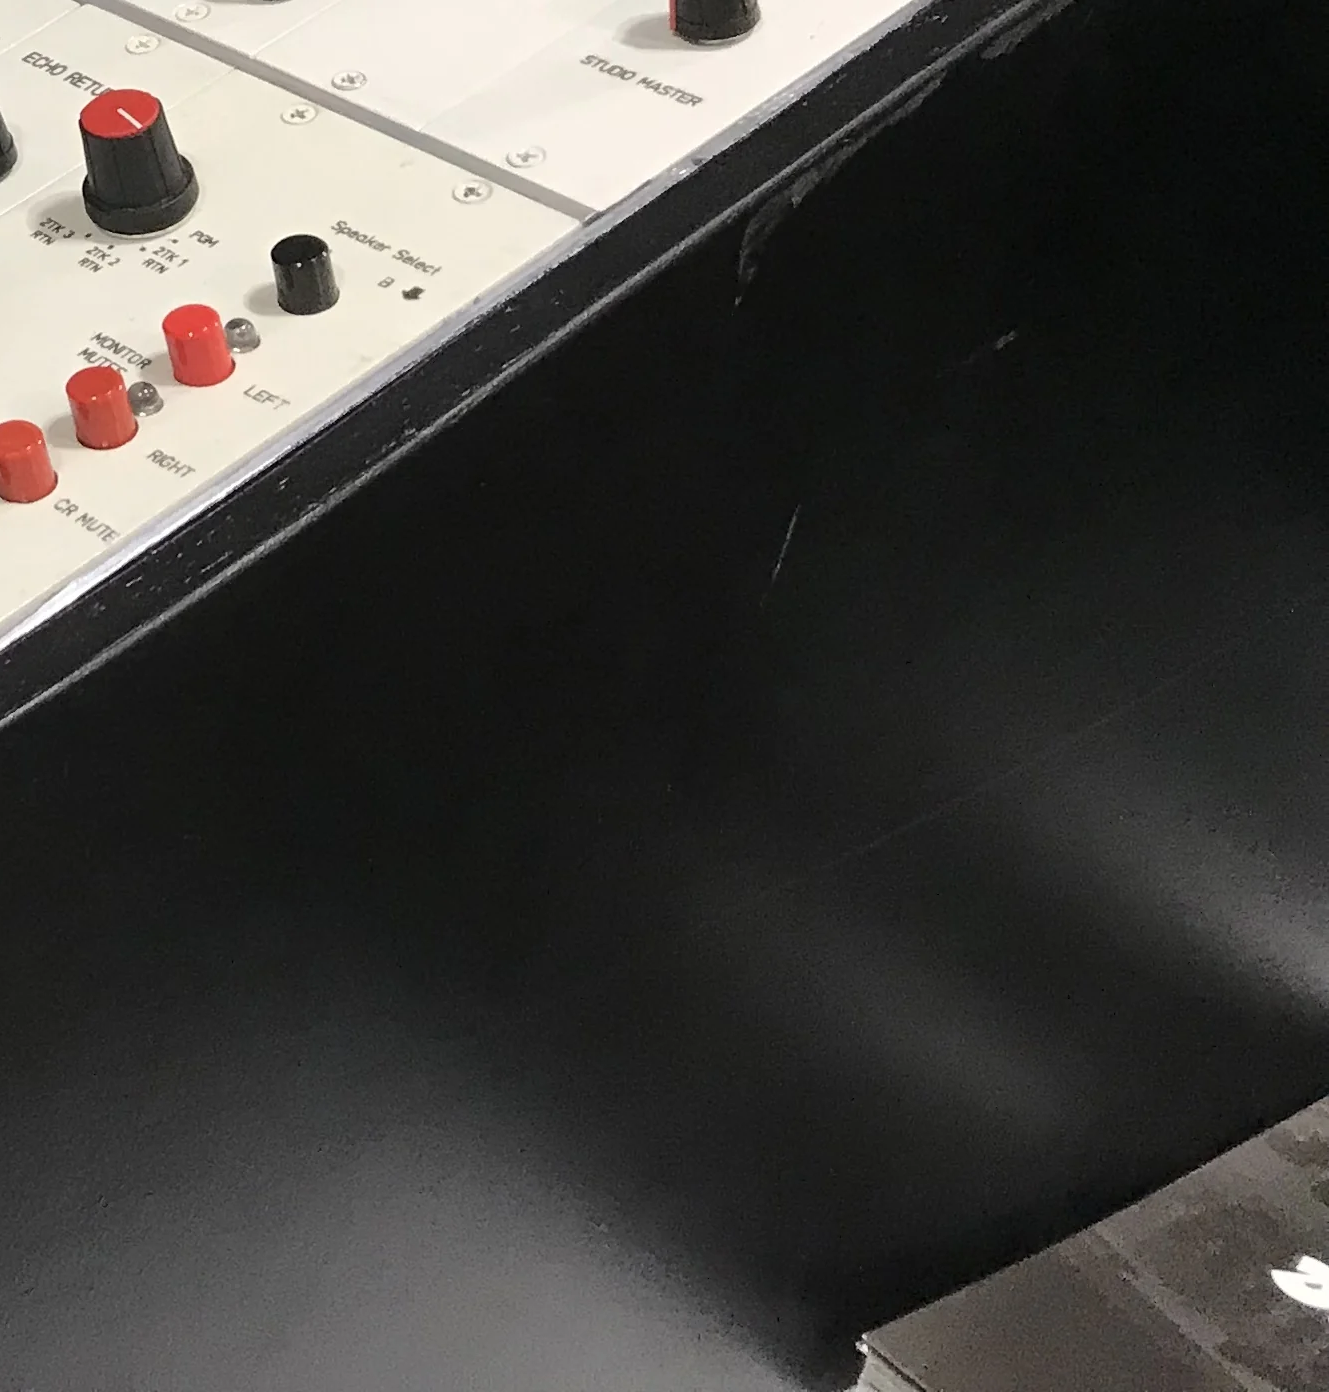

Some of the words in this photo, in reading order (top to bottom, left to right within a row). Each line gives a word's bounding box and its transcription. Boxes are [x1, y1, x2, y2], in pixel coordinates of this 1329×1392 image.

[21, 52, 68, 77] ECHO
[63, 71, 114, 97] RETU
[580, 54, 637, 81] STUDIO
[636, 77, 704, 107] MASTER
[39, 217, 65, 234] 2TK
[30, 229, 55, 247] RTN
[188, 229, 220, 248] PGM
[331, 220, 391, 252] Speaker
[392, 249, 442, 276] Select
[77, 257, 104, 273] RTN
[85, 246, 111, 262] 2TK
[152, 246, 180, 262] 2TK
[142, 258, 170, 274] RTN
[90, 332, 152, 369] MONITOR
[243, 383, 291, 411] LEFT
[146, 449, 197, 479] RIGHT
[52, 497, 80, 517] CR
[74, 512, 121, 543] MUTE
